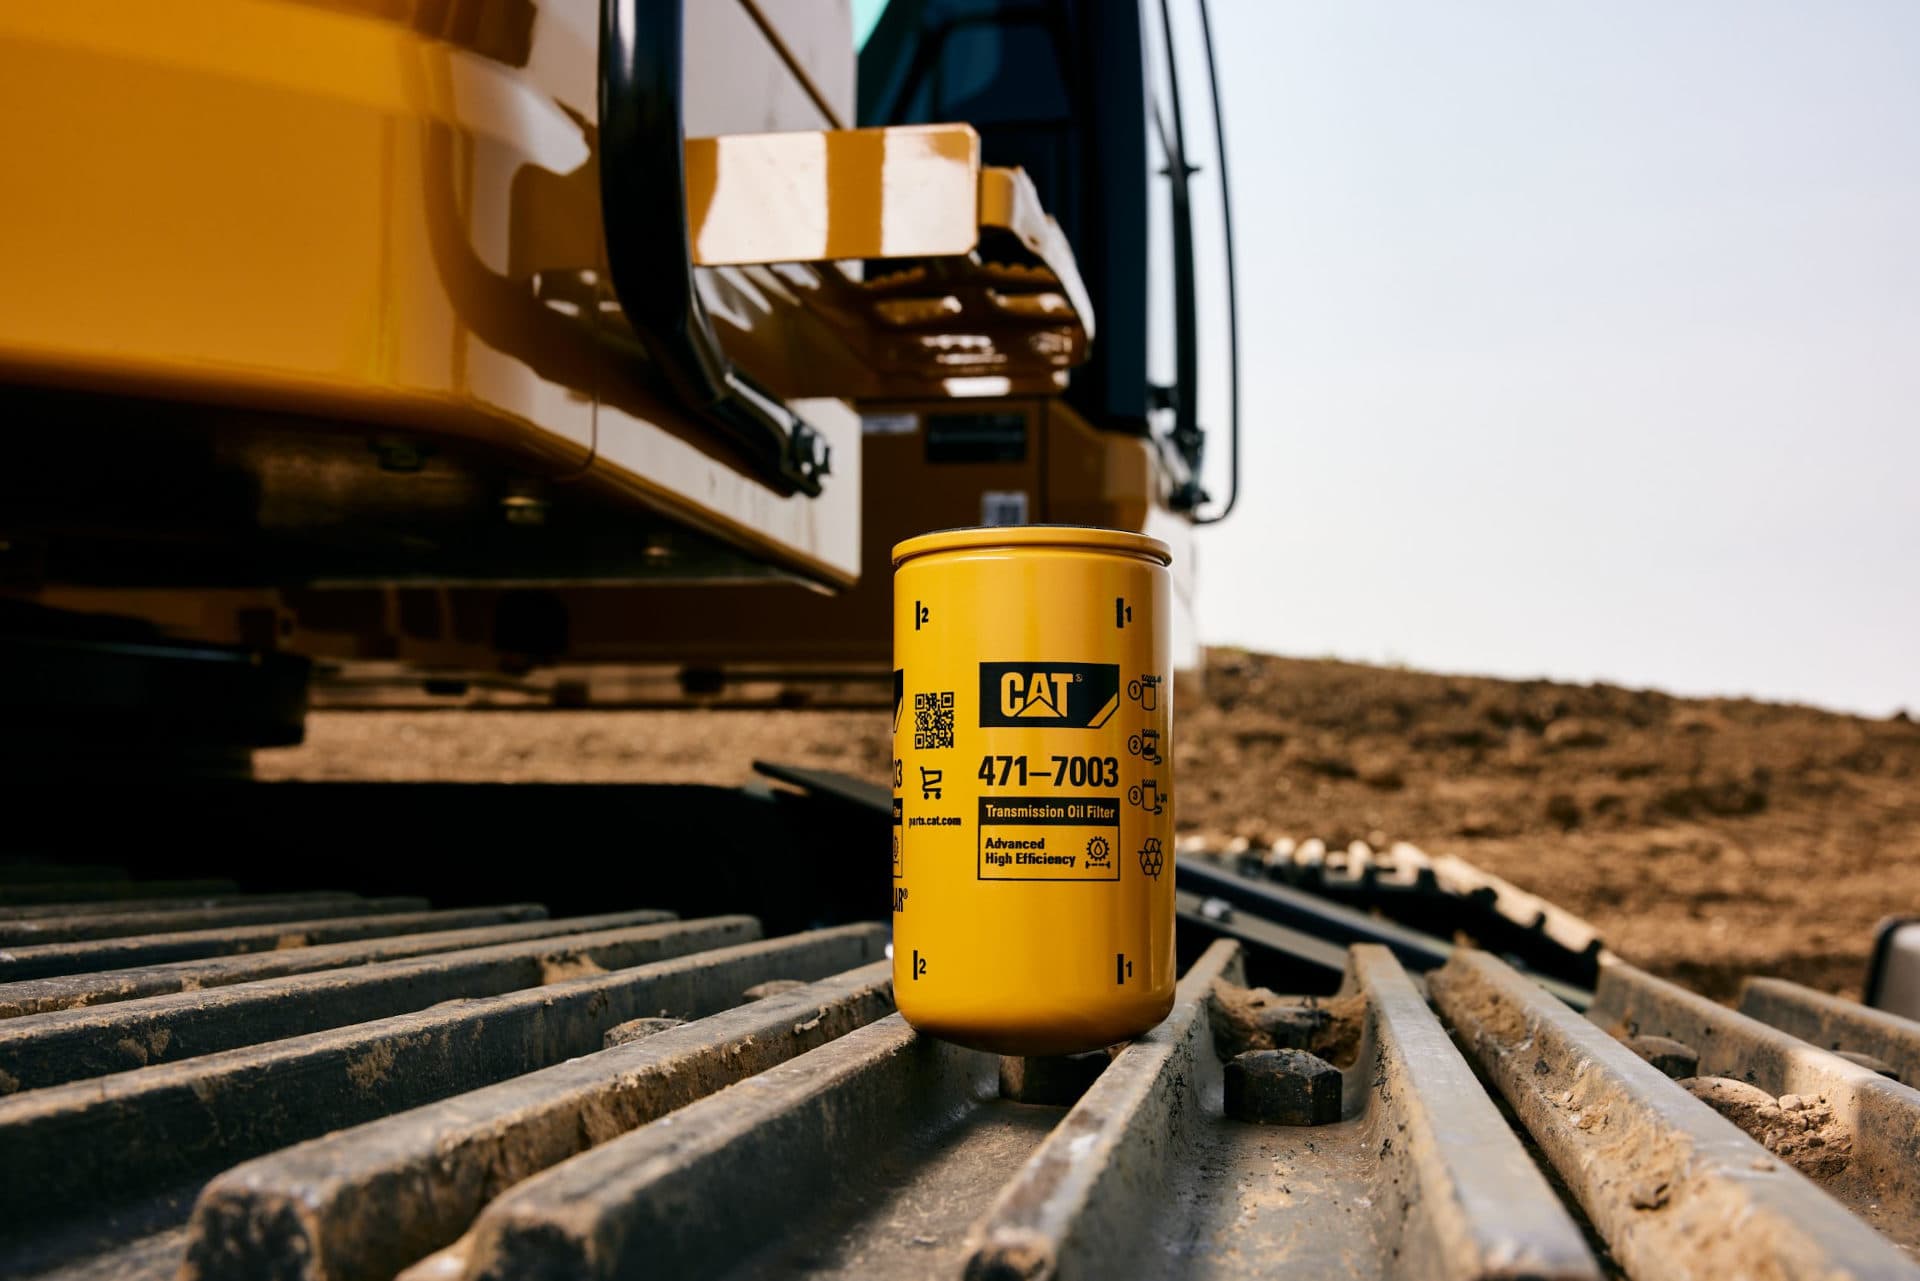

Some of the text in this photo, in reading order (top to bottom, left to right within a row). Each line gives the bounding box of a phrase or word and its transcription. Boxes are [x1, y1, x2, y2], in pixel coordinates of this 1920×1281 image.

[985, 804, 1115, 819] Transmission Oil Filter
[908, 815, 962, 828] parts.cat.com
[985, 837, 1045, 850] Advanced
[985, 852, 1076, 869] High Efficiency
